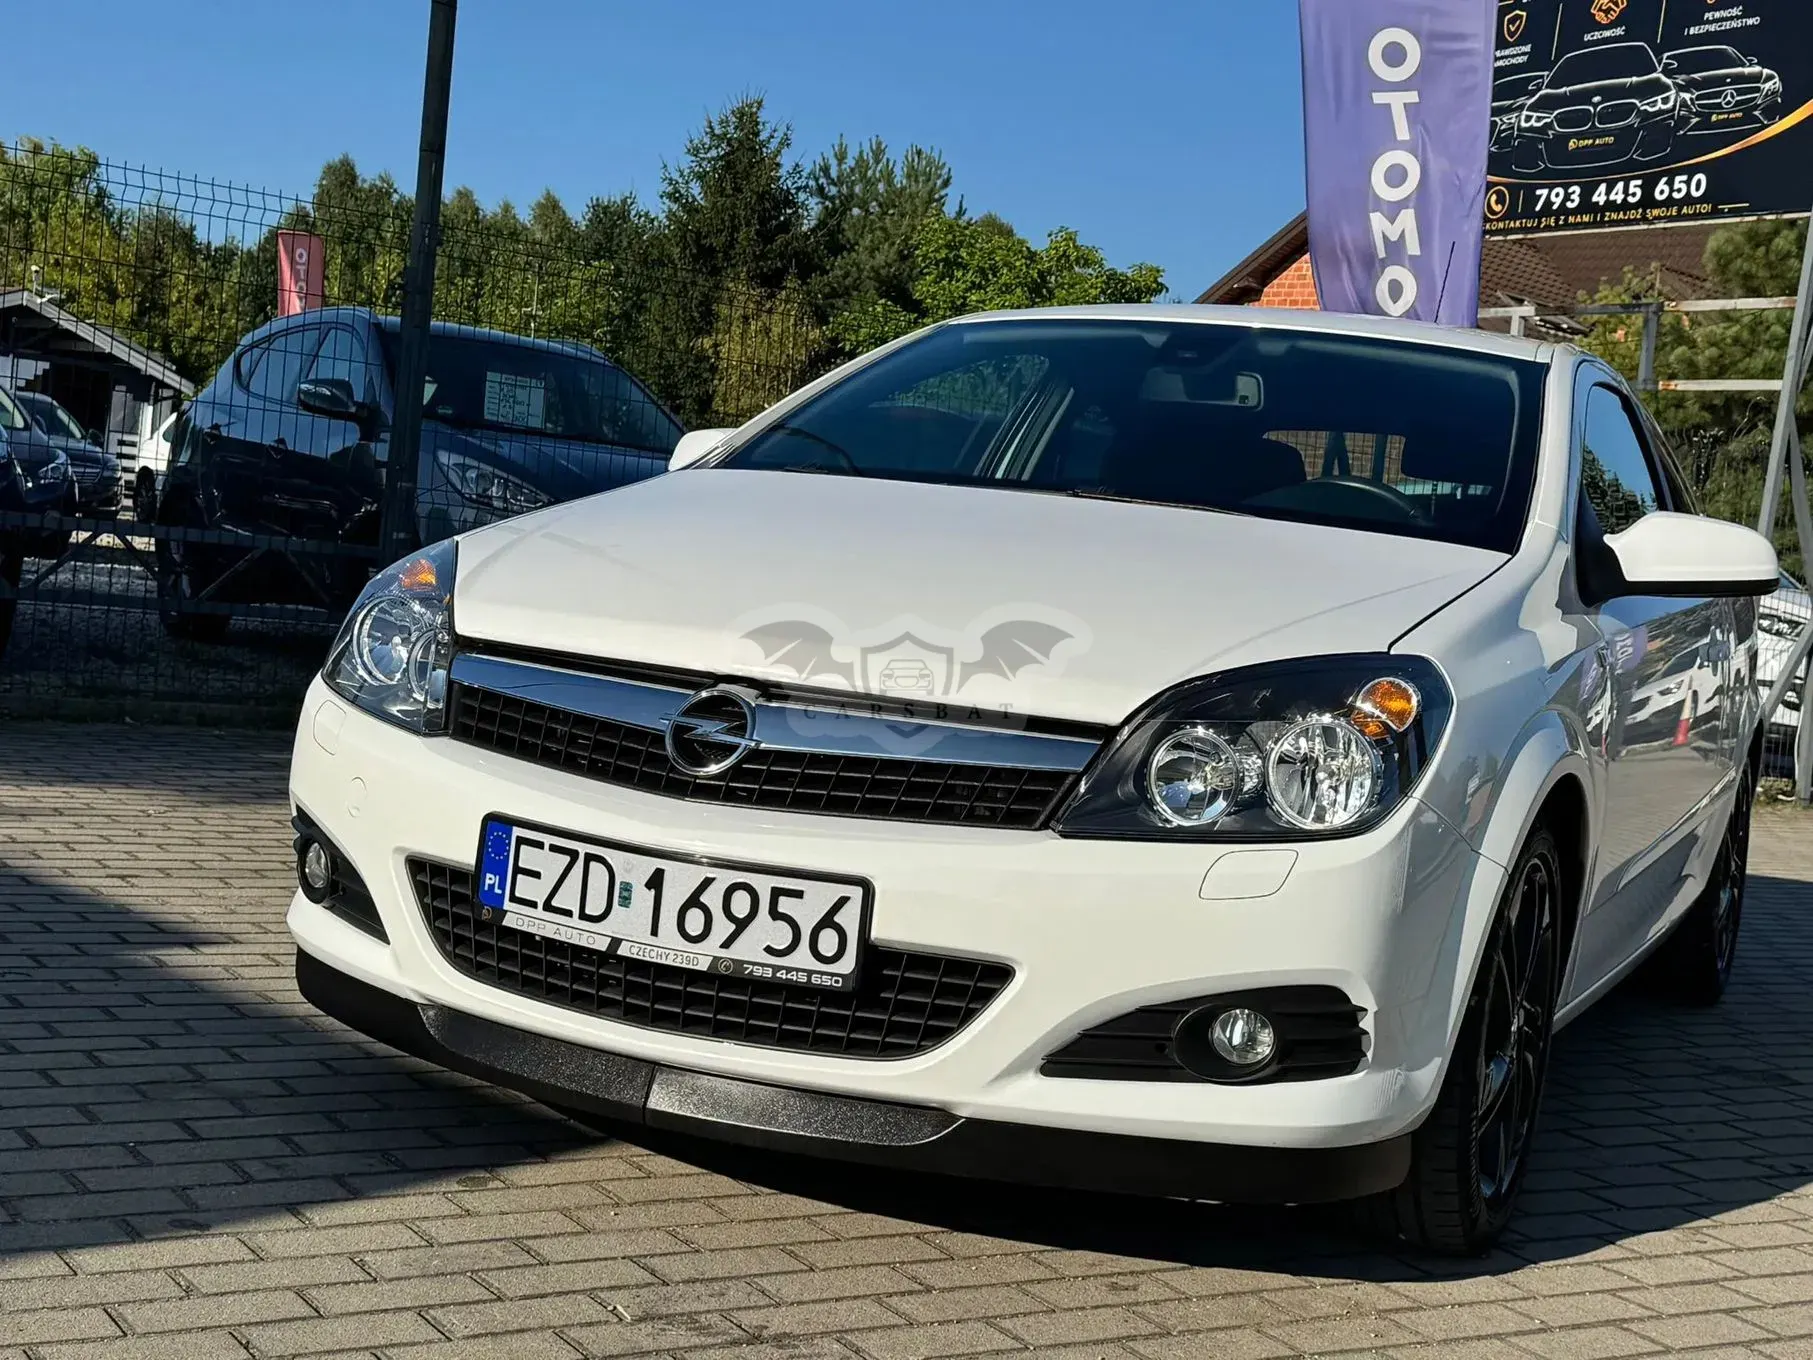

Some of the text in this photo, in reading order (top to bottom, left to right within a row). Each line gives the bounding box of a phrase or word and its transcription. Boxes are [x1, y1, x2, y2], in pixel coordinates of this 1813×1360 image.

[1703, 5, 1744, 21] PEWNOŚĆ
[1689, 16, 1761, 36] BEZPIECZEŃSTWO
[1594, 136, 1615, 145] AUTO
[1534, 172, 1707, 212] 793 445 650
[1541, 216, 1557, 228] SIĘ
[1558, 215, 1566, 225] Z
[1568, 213, 1594, 224] NAMI
[1604, 207, 1643, 221] ZNAJDŹ
[1645, 207, 1679, 220] SWOJE
[1681, 203, 1713, 215] AUTO!
[484, 872, 503, 894] PL
[508, 835, 851, 966] EZD 16956
[515, 917, 546, 932] DPP
[553, 927, 597, 946] AUTO
[628, 944, 700, 967] CZECHY 239D
[743, 964, 843, 988] 793 445 650
